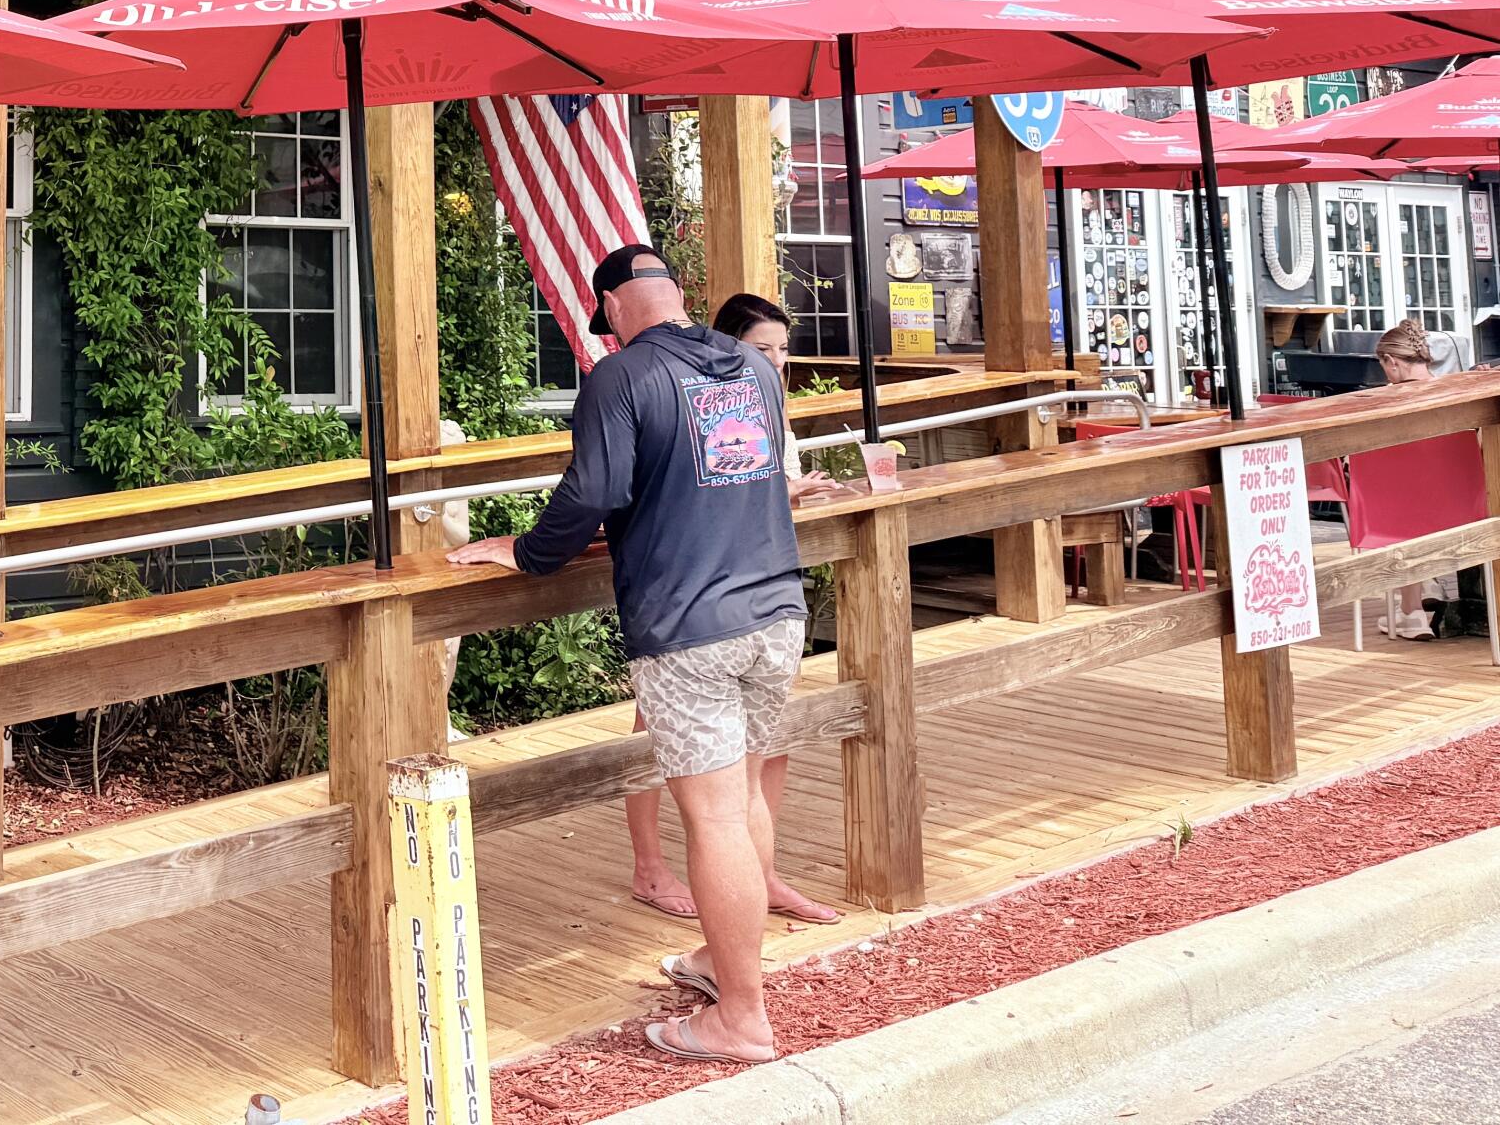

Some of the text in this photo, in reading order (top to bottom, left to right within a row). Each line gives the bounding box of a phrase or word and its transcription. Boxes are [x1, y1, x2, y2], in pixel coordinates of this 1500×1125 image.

[1339, 188, 1363, 200] WAYLON
[1474, 197, 1483, 209] NO
[1471, 213, 1490, 224] PARKING
[1476, 226, 1485, 234] ANY
[1476, 235, 1487, 244] TIME
[892, 294, 915, 306] Zone
[892, 313, 908, 325] BUS
[680, 376, 697, 387] 30A
[1242, 444, 1289, 467] PARKING
[1240, 467, 1296, 491] FOR TO-GO
[1250, 491, 1291, 514] ORDERS
[1261, 516, 1287, 536] ONLY
[1251, 620, 1311, 647] 850-231-1008
[404, 803, 418, 864] NO
[448, 819, 479, 1125] NO PARKING
